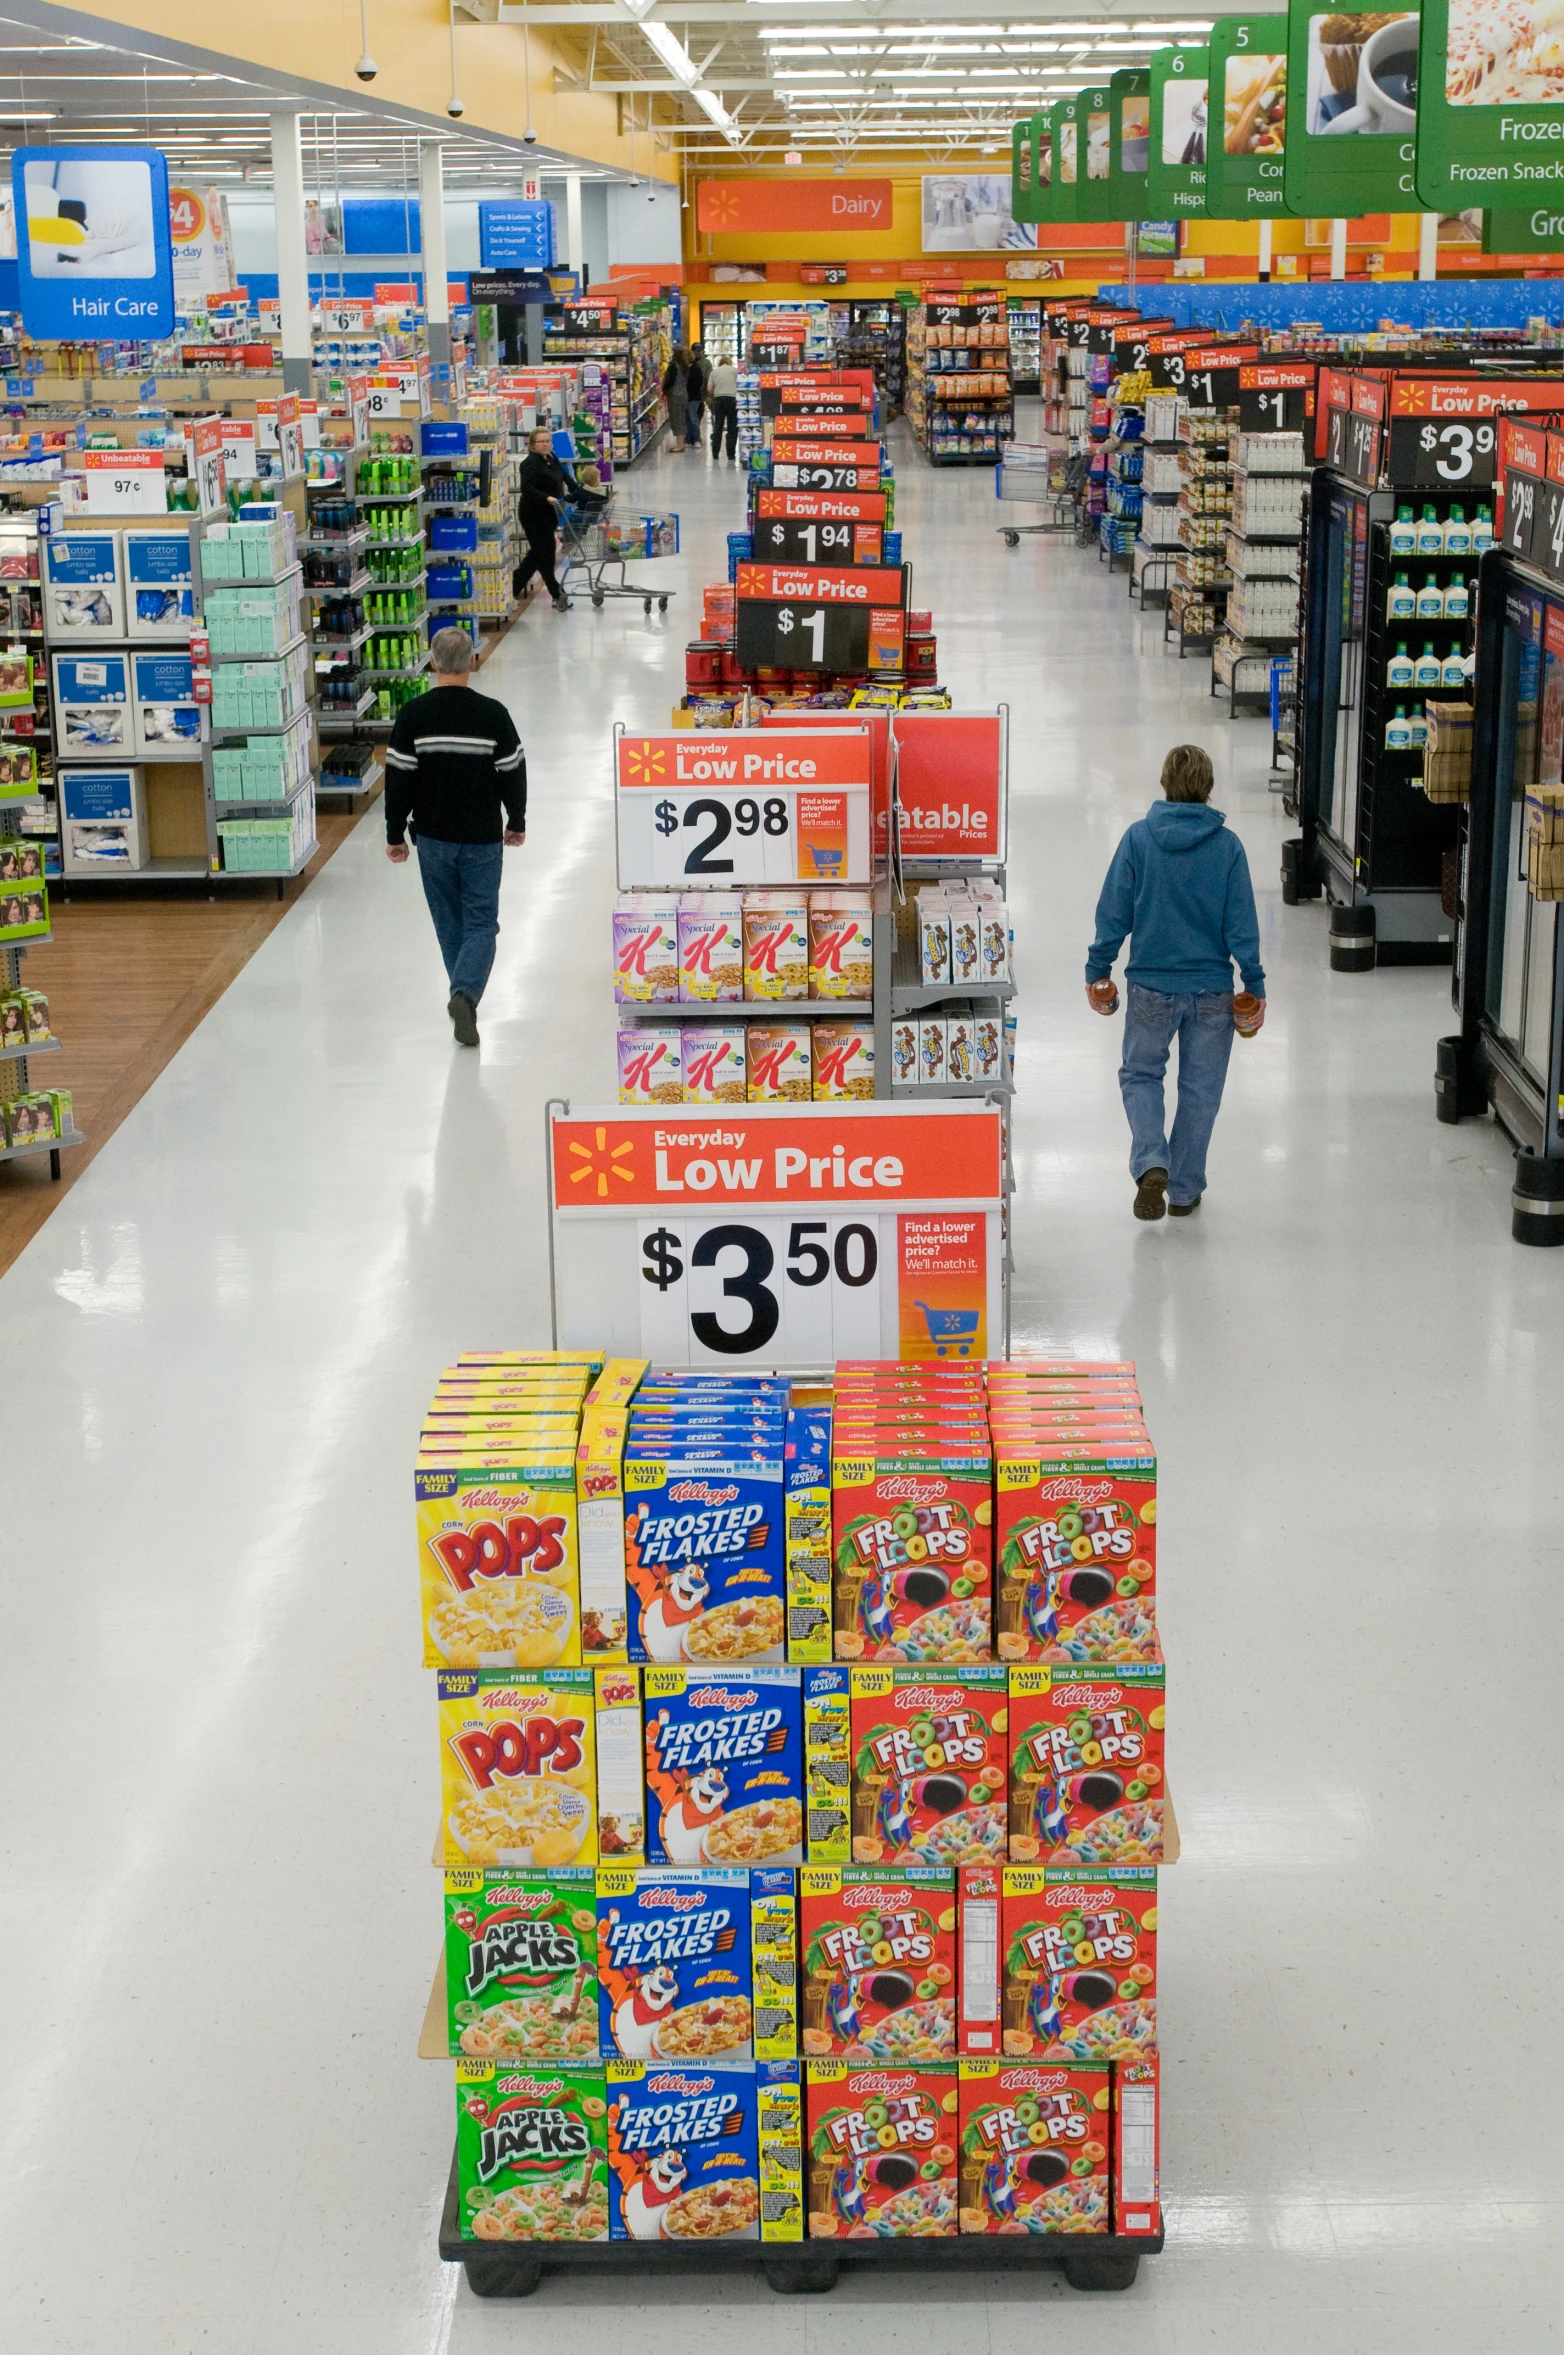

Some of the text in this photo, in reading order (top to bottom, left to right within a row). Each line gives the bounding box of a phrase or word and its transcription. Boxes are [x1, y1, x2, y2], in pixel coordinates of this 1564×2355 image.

[1236, 27, 1249, 47] 5
[1172, 55, 1184, 72] 6
[1129, 76, 1139, 91] 7
[1094, 94, 1103, 107] 8
[1066, 106, 1075, 118] 9
[1500, 118, 1564, 140] Froze
[1450, 163, 1508, 181] Frozen
[831, 195, 882, 218] Dairy
[1142, 220, 1173, 232] Candy
[508, 281, 526, 290] Every
[72, 297, 159, 317] Hair Care
[1201, 356, 1219, 367] Low
[1257, 372, 1306, 386] Low Price
[799, 392, 844, 402] Low Price
[1432, 385, 1468, 395] Everyday
[1432, 393, 1529, 412] Low Price
[796, 422, 847, 432] Low Price
[101, 453, 150, 464] Unbeatable
[796, 449, 857, 462] Low Price
[786, 502, 860, 517] Low Price
[147, 545, 178, 554] cotton
[772, 570, 808, 580] Everyday
[772, 578, 868, 599] Low Price
[154, 665, 185, 674] cotton
[676, 743, 727, 756] Everyday
[676, 753, 817, 780] Low Price
[82, 782, 113, 793] cotton
[959, 829, 988, 839] Prices
[654, 1129, 746, 1150] Everyday
[655, 1145, 904, 1191] Low Price
[905, 1221, 976, 1233] Find a lower
[905, 1232, 968, 1244] advertised
[905, 1245, 941, 1259] price?
[905, 1258, 930, 1270] We'll
[932, 1257, 966, 1269] match
[490, 1472, 518, 1481] FIBER
[626, 1465, 666, 1475] FAMILY
[693, 1466, 732, 1475] VITAMIN D
[833, 1462, 874, 1472] FAMILY
[841, 1471, 866, 1481] SIZE
[416, 1474, 457, 1484] FAMILY
[424, 1483, 449, 1493] SIZE
[633, 1474, 658, 1484] SIZE
[669, 1481, 739, 1505] Kellogg's
[877, 1478, 948, 1501] Kellogg's
[1042, 1479, 1113, 1502] Kellogg's
[461, 1489, 530, 1512] Kellogg's
[441, 1521, 464, 1529] CORN
[638, 1503, 764, 1544] FROSTED
[855, 1504, 953, 1556] FROOT
[1020, 1504, 1119, 1556] FROOT
[430, 1516, 567, 1593] POPS
[641, 1528, 748, 1564] FLAKES
[876, 1529, 968, 1569] LOOPS
[1042, 1530, 1133, 1570] LOOPS
[438, 1675, 478, 1684] FAMILY
[646, 1672, 686, 1682] FAMILY
[654, 1681, 678, 1691] SIZE
[853, 1673, 892, 1683] FAMILY
[860, 1681, 885, 1691] SIZE
[446, 1683, 470, 1693] SIZE
[482, 1690, 549, 1713] Kellogg's
[689, 1686, 759, 1711] Kellogg's
[895, 1688, 963, 1709] Kellogg's
[462, 1720, 484, 1728] CORN
[658, 1708, 782, 1748] FROSTED
[875, 1713, 969, 1763] FROOT
[450, 1715, 585, 1791] POPS
[661, 1732, 766, 1770] FLAKES
[895, 1737, 984, 1776] LOOPS
[444, 1870, 483, 1880] FAMILY
[452, 1878, 476, 1888] SIZE
[485, 1887, 553, 1910] Kellogg's
[638, 1887, 707, 1911] Kellogg's
[844, 1887, 912, 1911] Kellogg's
[486, 1922, 554, 1941] APPLE
[610, 1909, 730, 1947] FROSTED
[824, 1912, 917, 1960] FROOT
[613, 1933, 715, 1966] FLAKES
[844, 1936, 932, 1972] LOOPS
[467, 1937, 578, 1995] JACKS
[498, 2074, 564, 2097] Kellogg's
[648, 2073, 715, 2096] Kellogg's
[850, 2071, 916, 2094] Kellogg's
[1001, 2069, 1068, 2093] Kellogg's
[499, 2109, 564, 2127] APPLE
[620, 2094, 738, 2130] FROSTED
[830, 2096, 921, 2143] FROOT
[982, 2093, 1073, 2140] FROOT
[622, 2117, 722, 2150] FLAKES
[850, 2119, 936, 2155] LOOPS
[1000, 2116, 1087, 2152] LOOPS
[480, 2123, 587, 2181] JACKS
